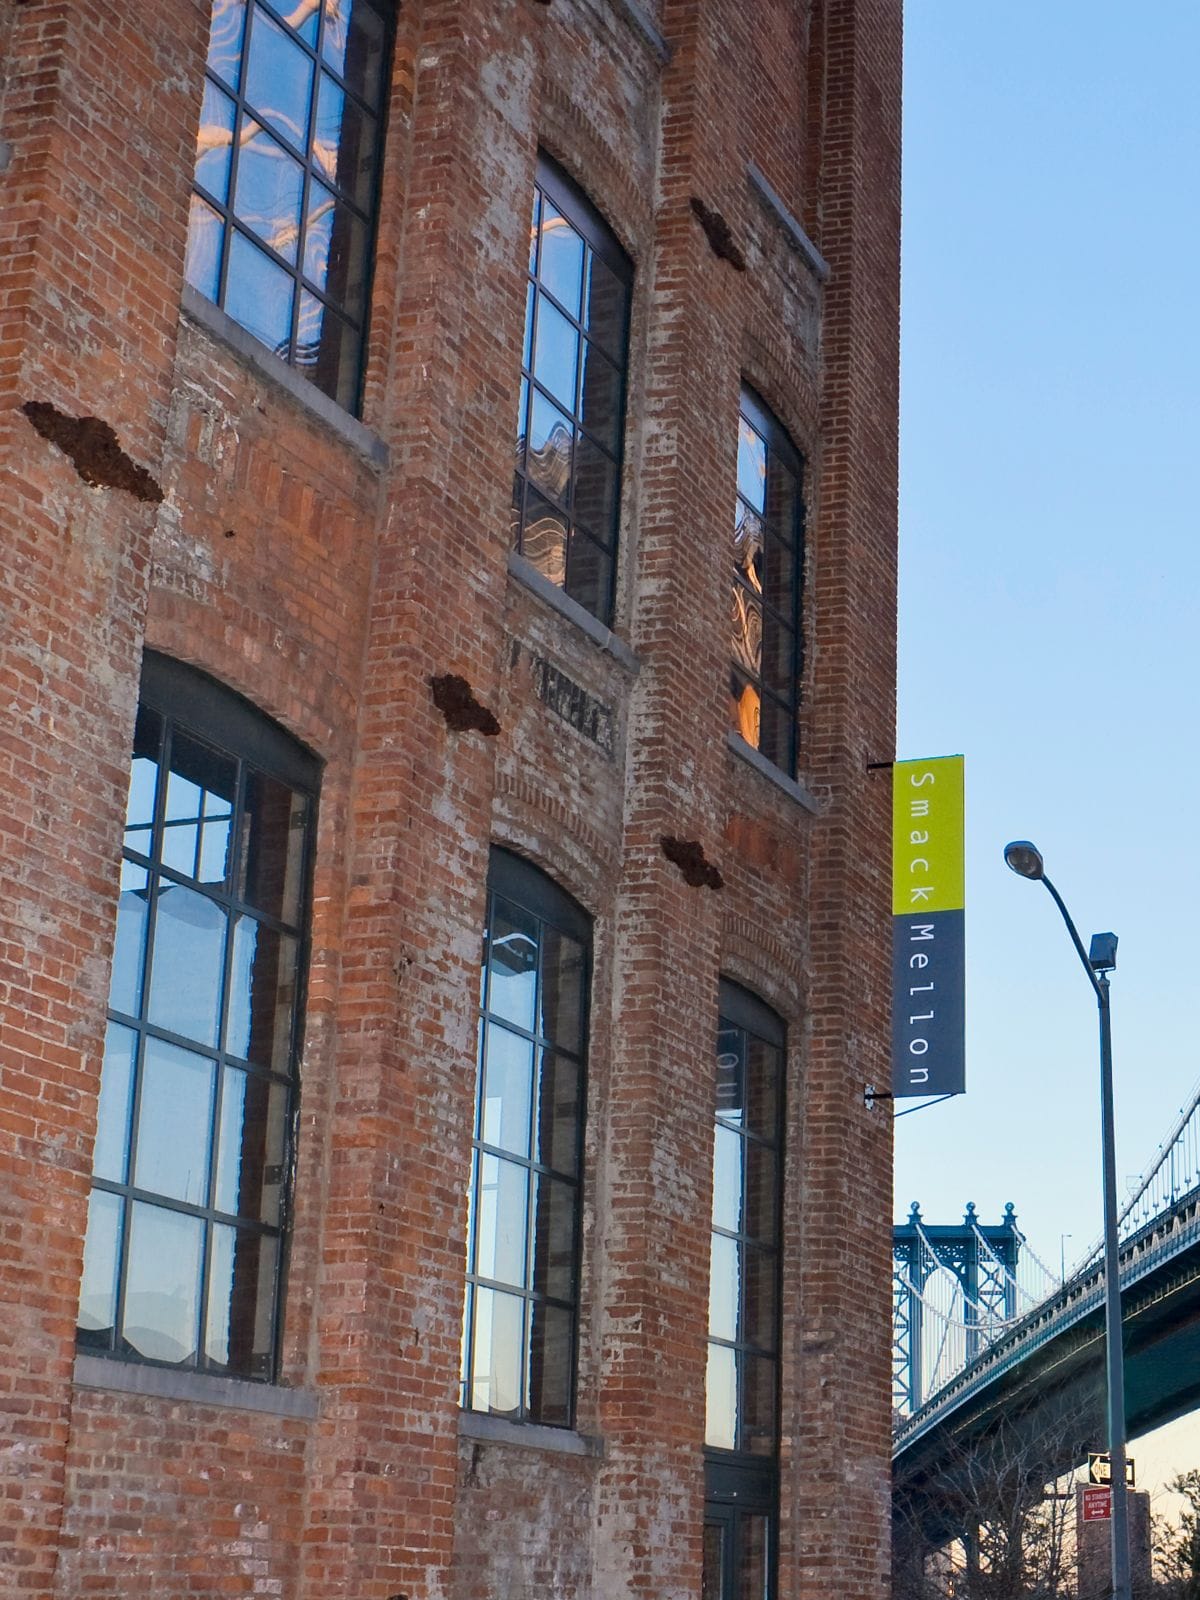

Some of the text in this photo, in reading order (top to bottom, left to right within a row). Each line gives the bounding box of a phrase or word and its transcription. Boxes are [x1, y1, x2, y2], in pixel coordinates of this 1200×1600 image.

[910, 772, 935, 1084] Smack Mellon
[1095, 1463, 1107, 1476] ONE
